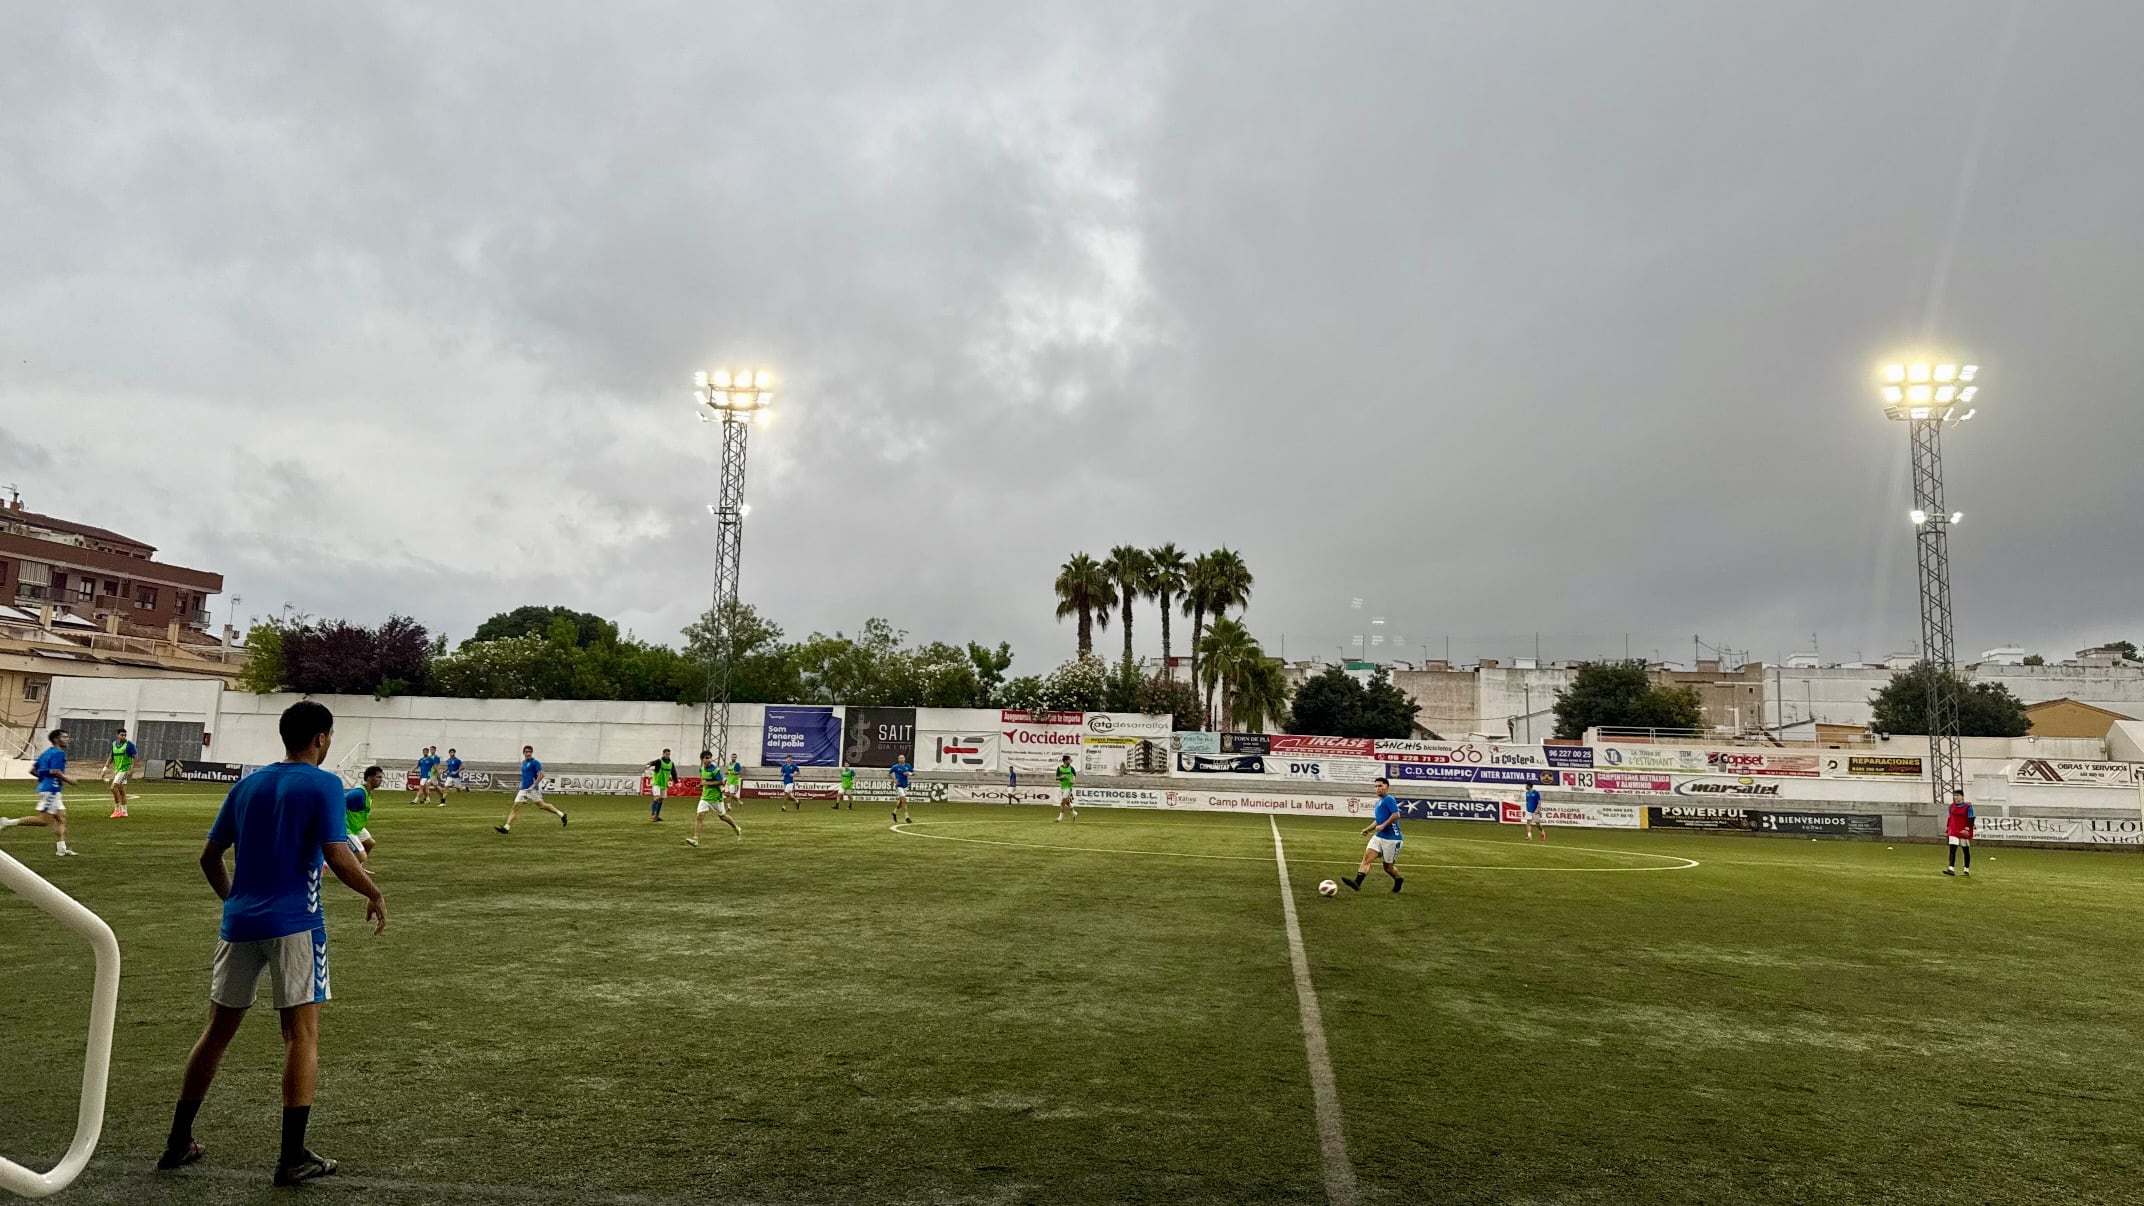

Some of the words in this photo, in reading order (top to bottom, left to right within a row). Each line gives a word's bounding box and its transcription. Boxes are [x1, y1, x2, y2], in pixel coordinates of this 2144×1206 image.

[768, 725, 787, 733] Som
[878, 724, 913, 741] SAIT
[767, 732, 805, 742] l'energia
[1019, 730, 1081, 745] Occident
[1307, 737, 1369, 748] INCASE
[767, 739, 780, 747] del
[781, 739, 805, 748] poble
[1374, 740, 1422, 751] SANCHIS
[1490, 754, 1500, 764] La
[1501, 753, 1535, 765] Costera
[1720, 753, 1764, 767] Copiset
[1851, 757, 1920, 766] REPARACIONES
[1290, 763, 1320, 774] DVS
[1405, 767, 1425, 775] C.D.
[1480, 770, 1500, 779] INTER
[1501, 771, 1525, 780] XATIVA
[2091, 764, 2128, 772] SERVICIOS
[1578, 773, 1593, 787] R3
[911, 783, 932, 792] PEREZ
[1690, 784, 1779, 795] marsatel
[1075, 790, 1138, 799] ELECTROCES
[1208, 796, 1238, 809] Camp
[1240, 797, 1288, 810] Municipal
[1290, 799, 1303, 809] La
[1308, 801, 1334, 811] Murta
[1426, 801, 1497, 812] VERNISA
[1545, 811, 1586, 820] CAREMI
[1661, 806, 1748, 818] POWERFUL
[1778, 816, 1846, 825] BIENVENIDOS
[1982, 817, 2049, 832] RIGRAU
[2050, 825, 2066, 833] S.L.
